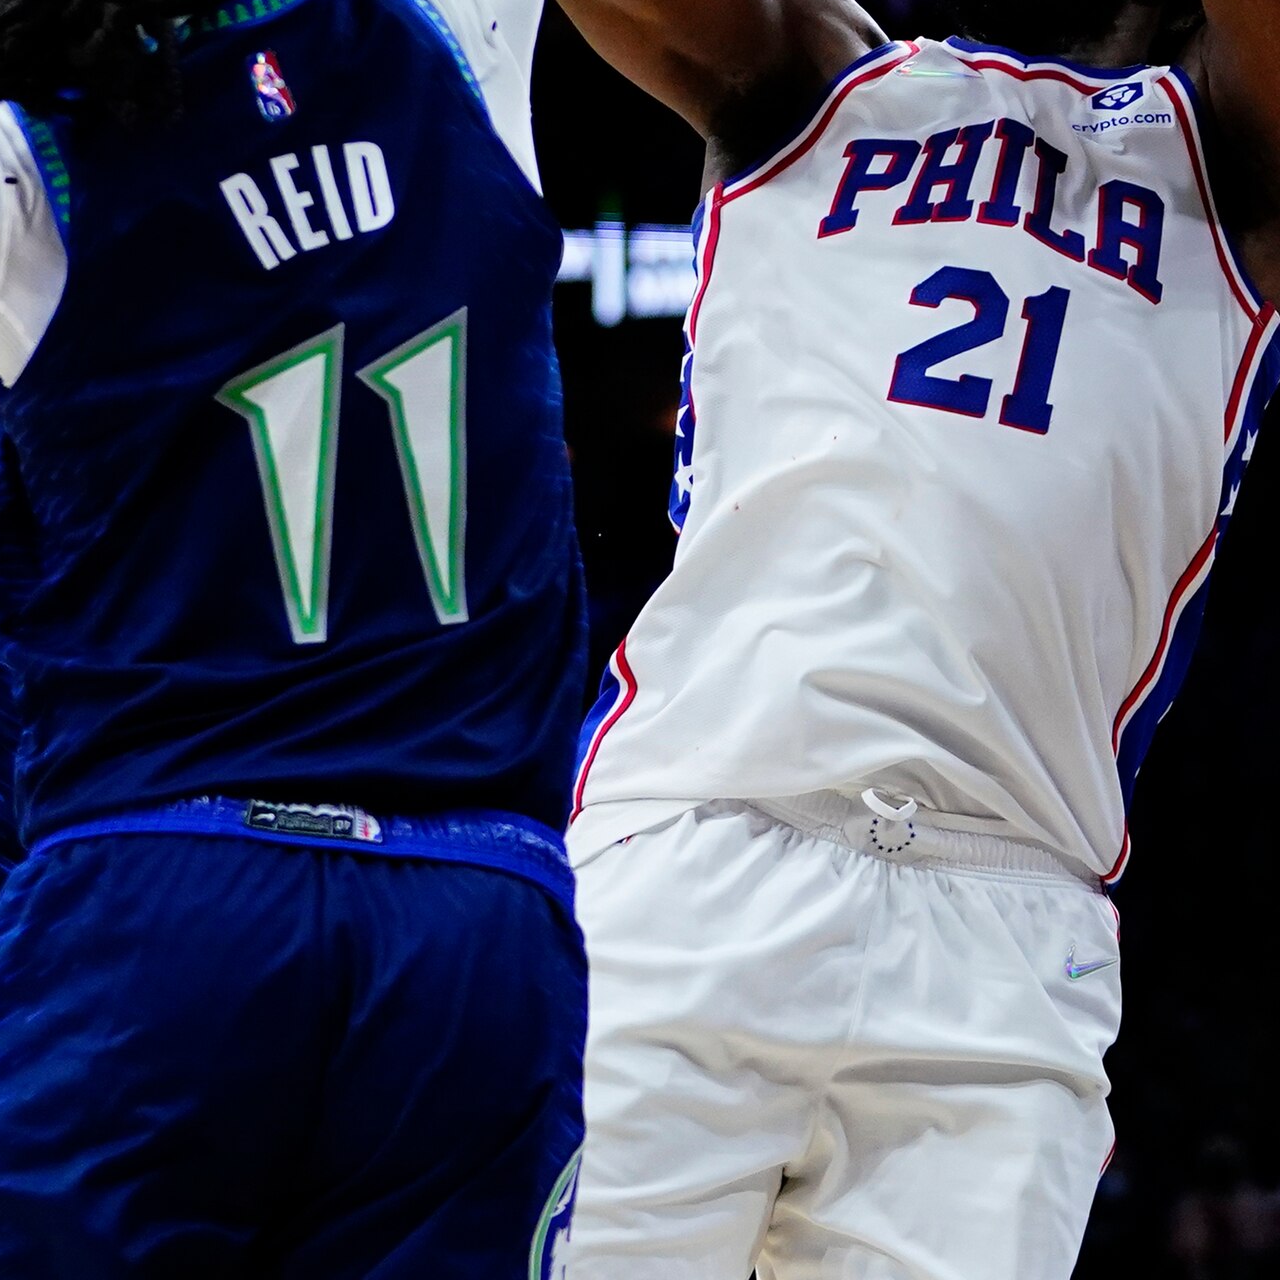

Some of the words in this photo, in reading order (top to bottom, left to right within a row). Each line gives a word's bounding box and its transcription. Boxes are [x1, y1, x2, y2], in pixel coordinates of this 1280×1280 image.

[220, 141, 395, 270] REID
[1071, 112, 1172, 133] crypto.com
[817, 117, 1165, 305] PHILA
[887, 265, 1071, 435] 21
[214, 305, 469, 644] 11
